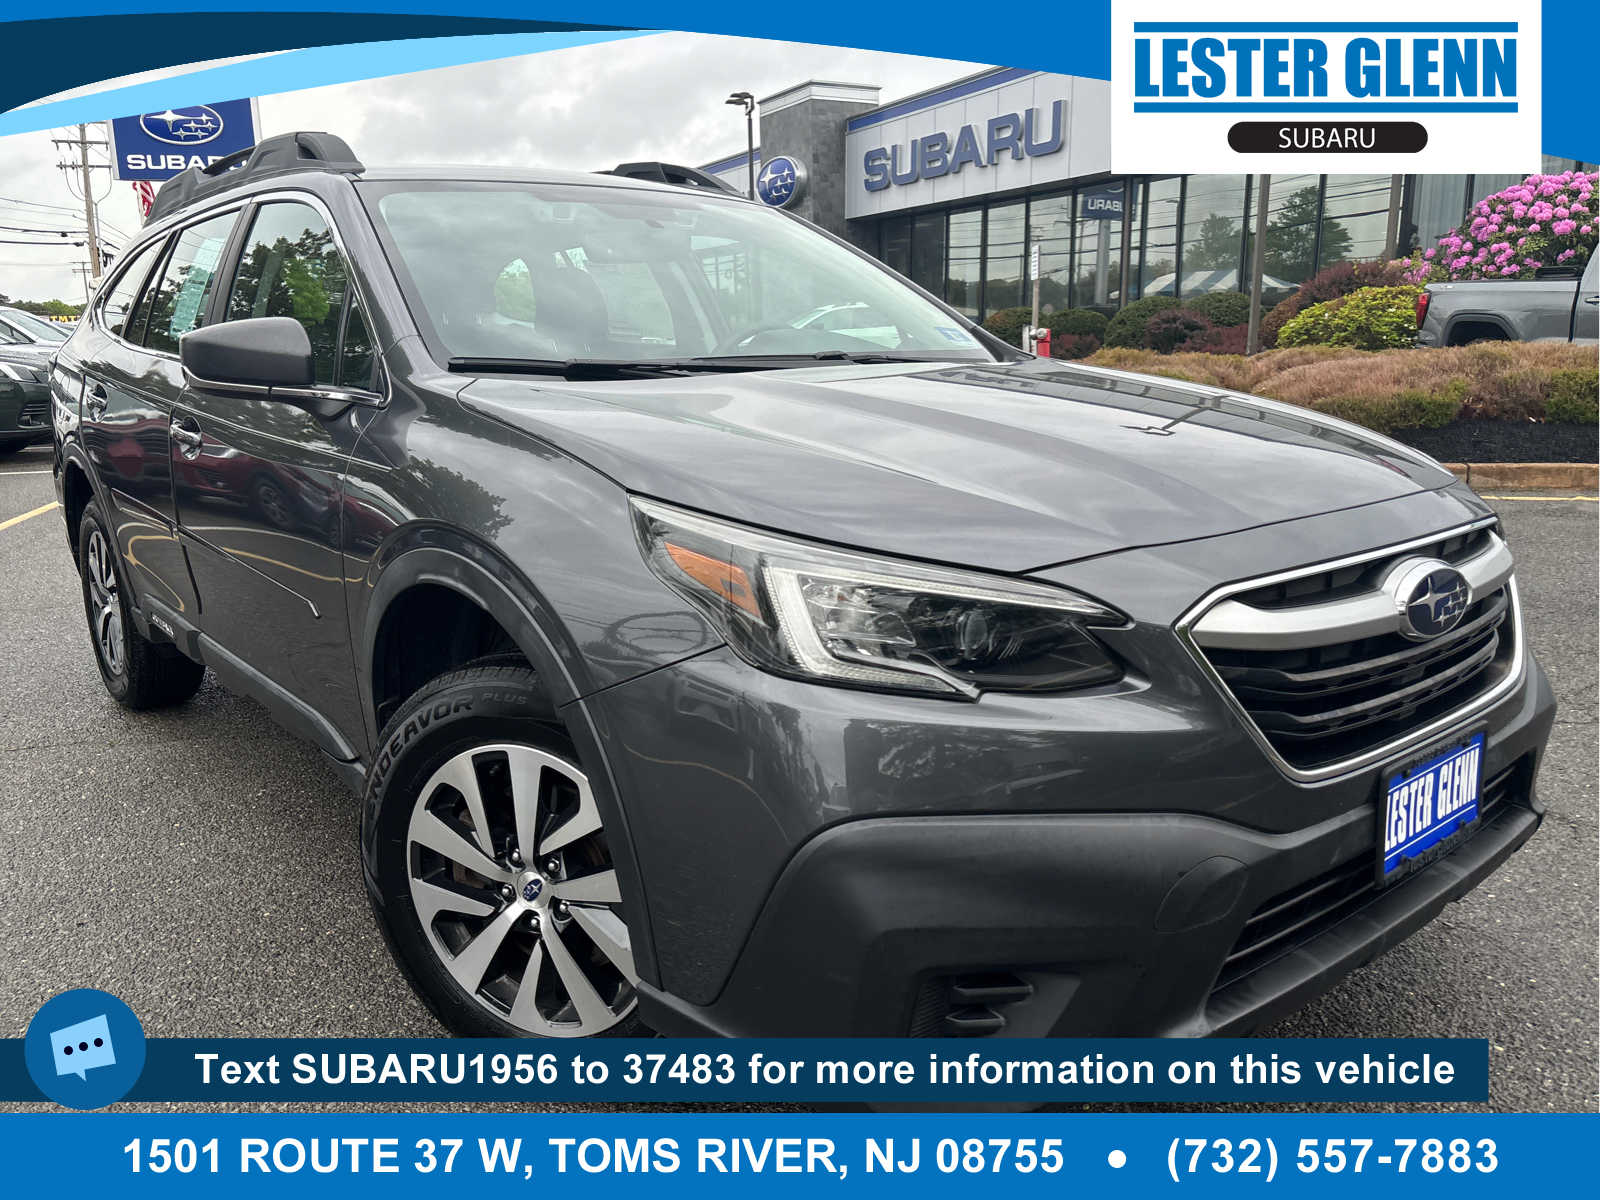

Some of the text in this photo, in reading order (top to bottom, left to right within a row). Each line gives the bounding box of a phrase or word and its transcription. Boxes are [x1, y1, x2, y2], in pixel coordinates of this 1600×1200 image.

[126, 154, 248, 171] SUBA
[863, 99, 1067, 193] SUBARU
[482, 692, 528, 705] PLUS
[1385, 748, 1480, 853] LESTER GLENN
